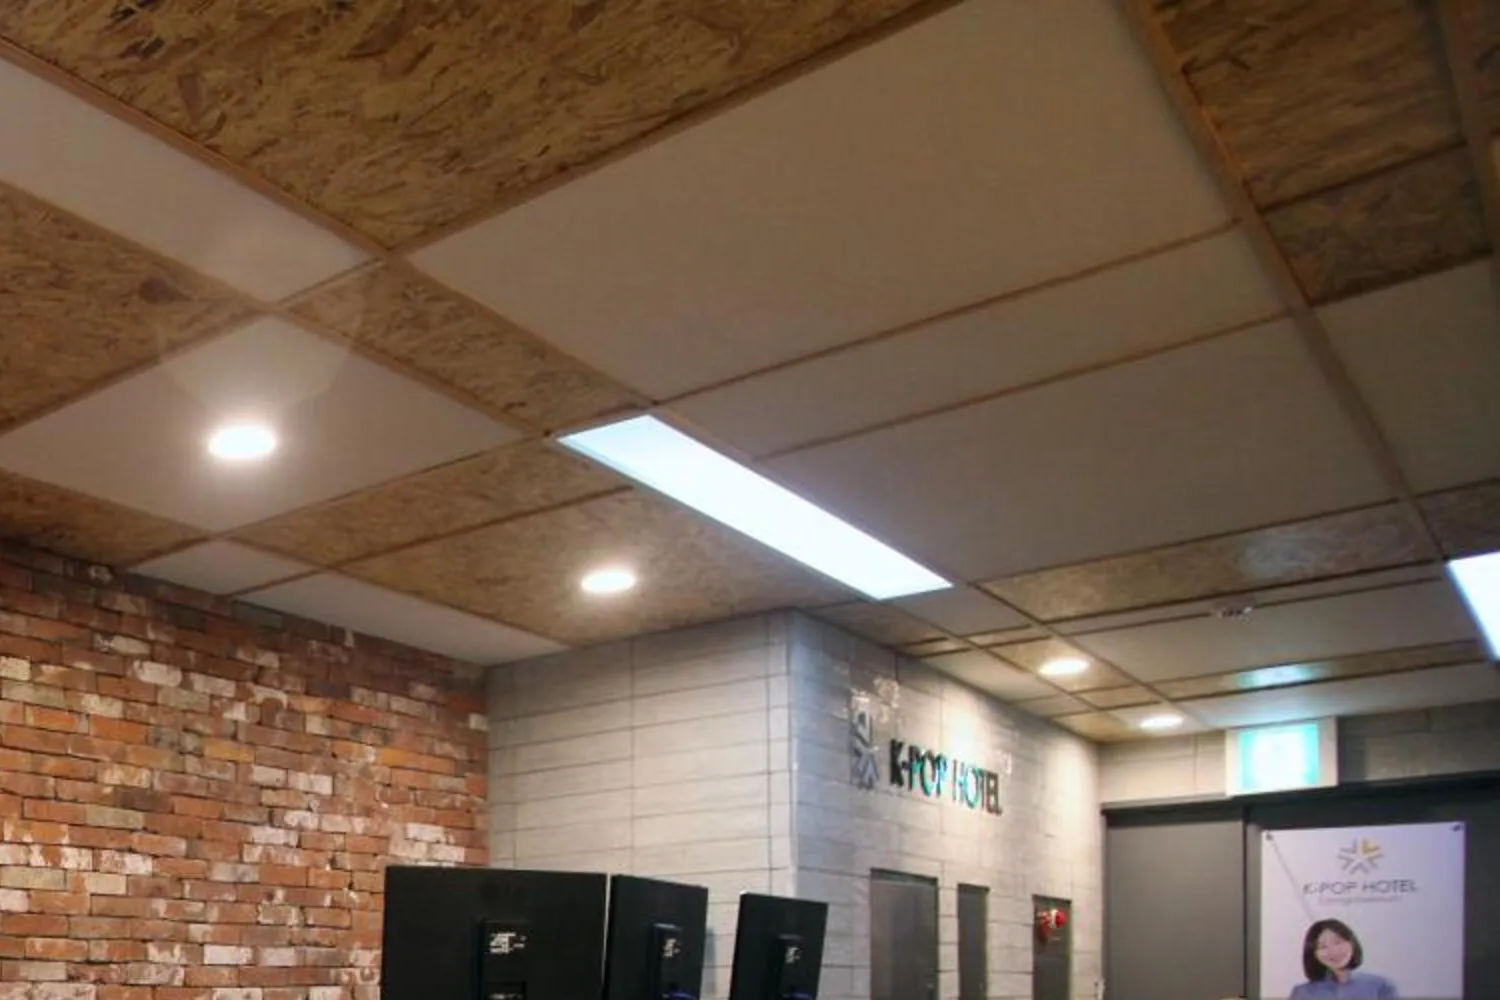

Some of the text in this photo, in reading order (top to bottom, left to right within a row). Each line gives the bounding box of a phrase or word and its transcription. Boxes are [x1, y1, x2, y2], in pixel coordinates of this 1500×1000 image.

[889, 737, 1003, 816] K-POP HOTEL
[1302, 879, 1418, 894] K-POP HOTEL
